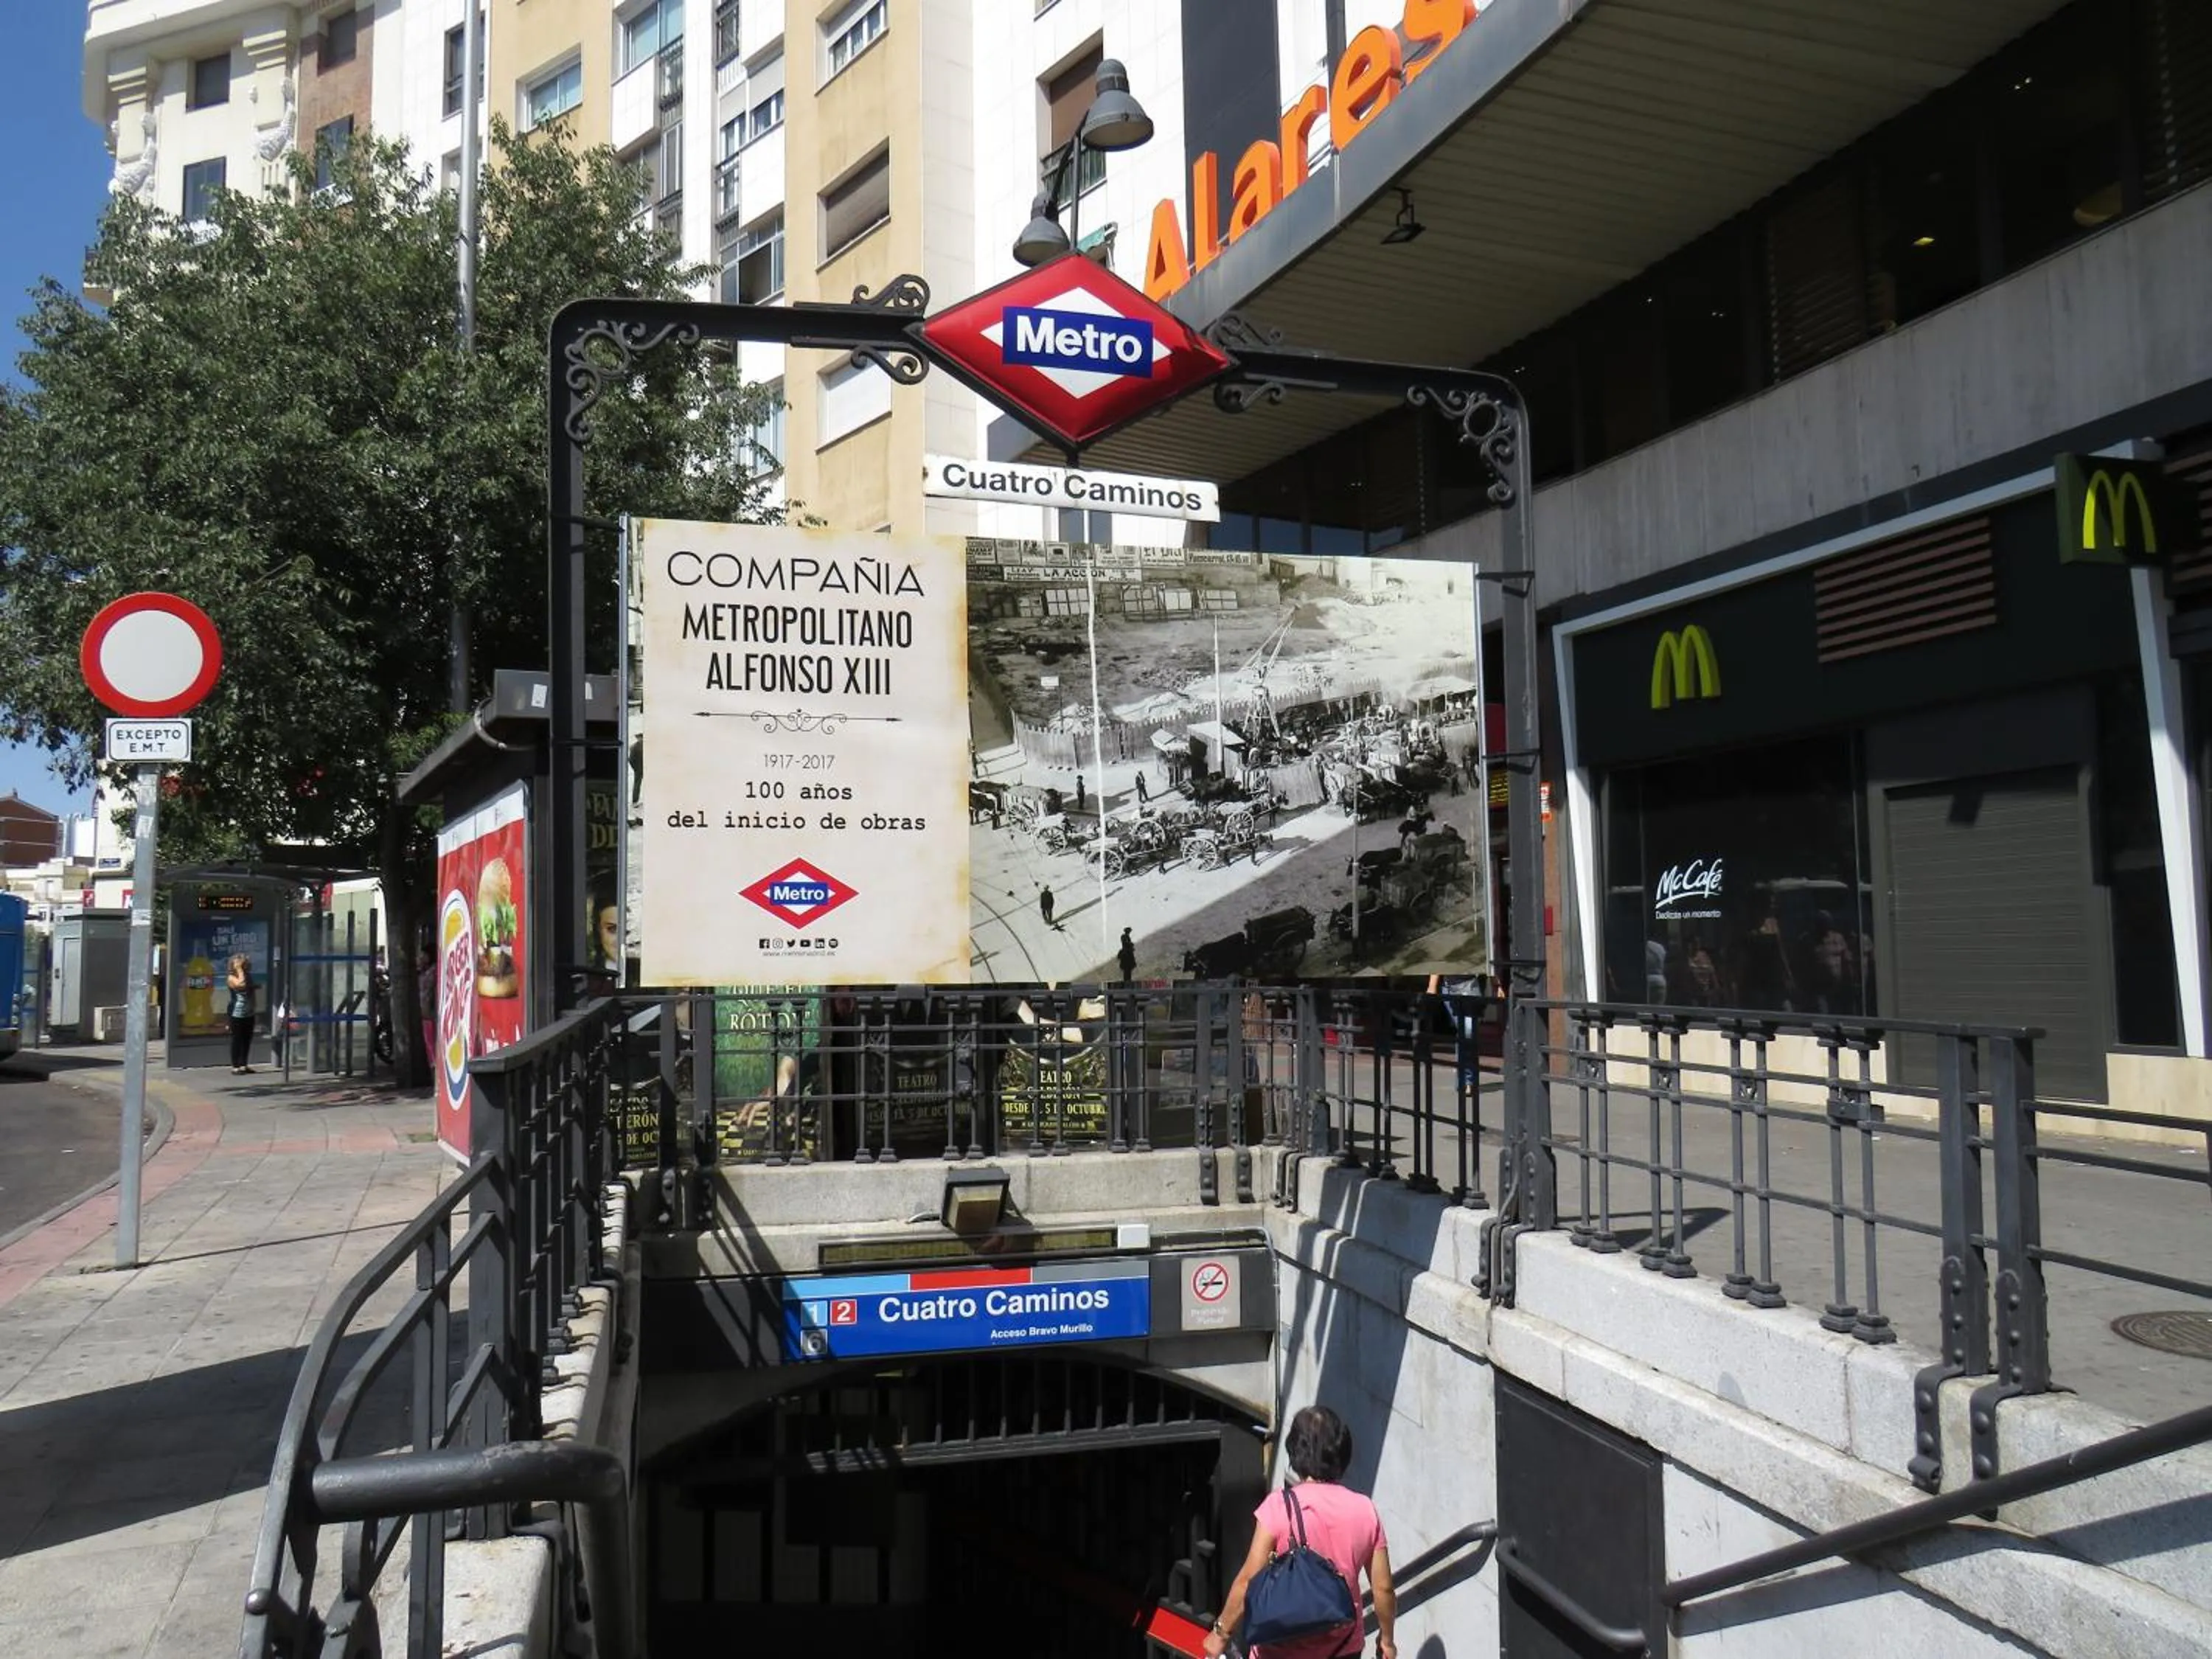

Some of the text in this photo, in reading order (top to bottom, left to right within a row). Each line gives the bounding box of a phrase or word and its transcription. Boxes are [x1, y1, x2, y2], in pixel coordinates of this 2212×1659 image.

[1143, 0, 1475, 302] Alares
[1017, 315, 1142, 364] Metro
[942, 463, 1202, 511] Cuatro Caminos
[667, 551, 925, 597] COMPAÑIA
[682, 603, 913, 648] METROPOLITANO
[706, 653, 891, 695] ALFONSO XIII
[116, 729, 182, 740] EXCEPTO
[764, 754, 835, 770] 1917-2017
[745, 782, 853, 801] 100 años
[667, 810, 926, 831] del inicio de obras
[773, 886, 825, 900] Metro
[1655, 858, 1723, 905] McCafé
[810, 1301, 852, 1324] 1 2
[878, 1287, 1110, 1323] Cuatro Caminos
[807, 1332, 821, 1355] 6
[990, 1323, 1093, 1339] Acceso Bravo Murillo
